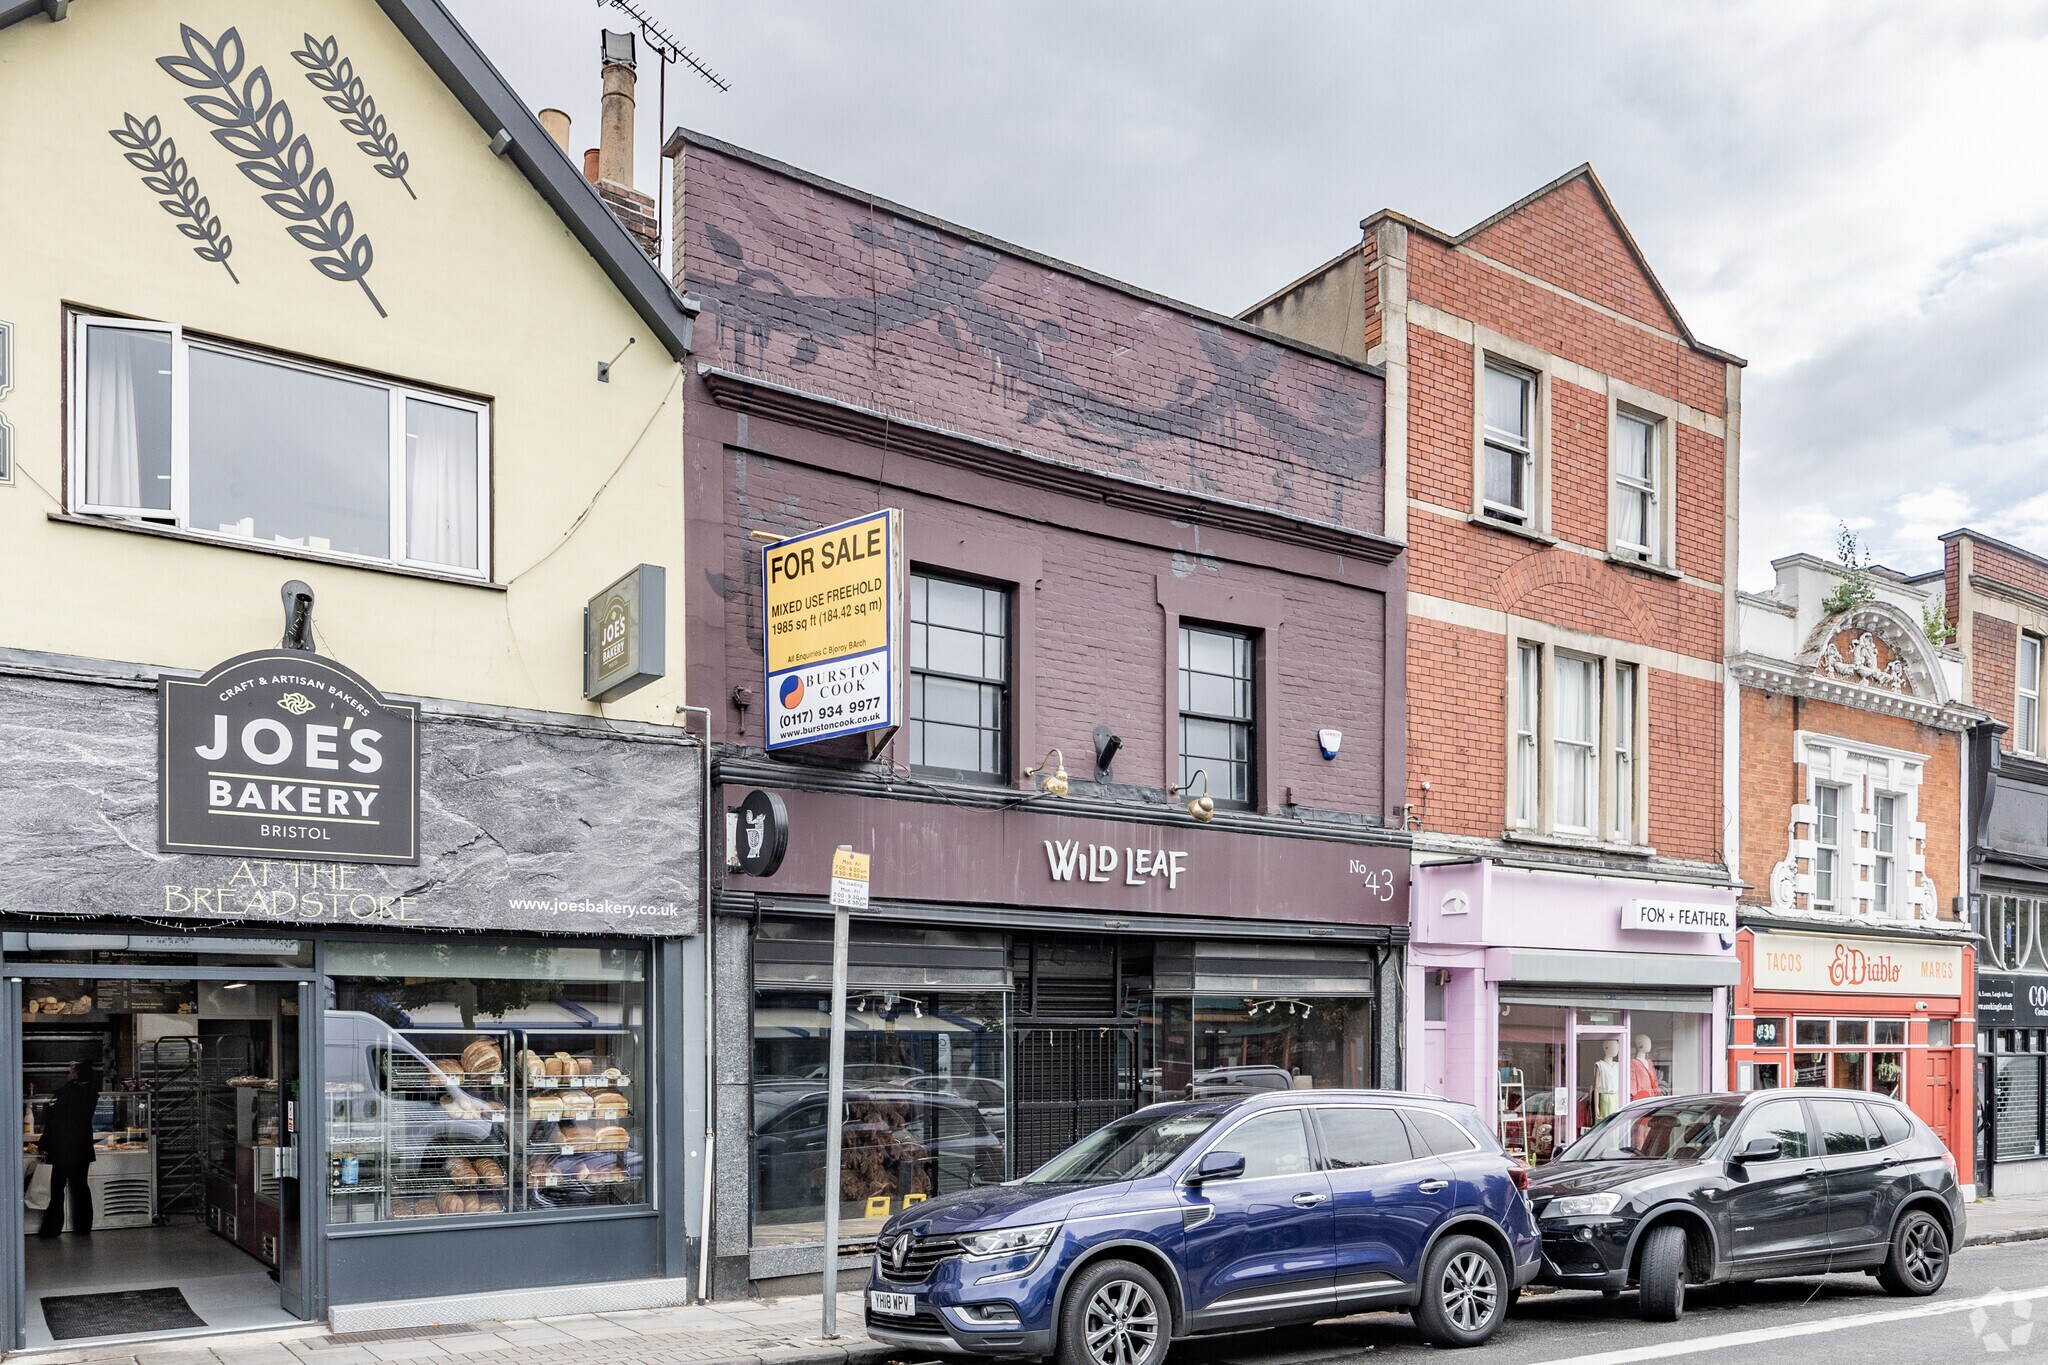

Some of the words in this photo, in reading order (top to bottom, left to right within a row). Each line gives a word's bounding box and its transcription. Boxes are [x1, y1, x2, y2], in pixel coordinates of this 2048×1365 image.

[771, 547, 815, 584] FOR
[821, 528, 881, 570] SALE
[771, 599, 802, 618] MIXED
[805, 592, 824, 610] USE
[827, 578, 882, 605] FREEHOLD
[602, 614, 625, 646] JOE'S
[772, 619, 794, 636] 1985
[796, 617, 807, 632] sq
[809, 613, 817, 627] ft
[818, 605, 852, 627] (184.42
[854, 603, 867, 619] sq
[868, 596, 883, 613] m)
[603, 641, 625, 662] BAKERY
[787, 654, 795, 664] All
[796, 648, 822, 662] Enquiries
[822, 646, 828, 655] C
[848, 639, 867, 651] BArch
[806, 660, 881, 688] BURSTON
[819, 678, 866, 699] COOK
[219, 679, 255, 702] CRAFT
[258, 676, 268, 686] &
[272, 674, 325, 691] ARTISAN
[328, 684, 370, 718] BAKERS
[779, 708, 814, 729] (0117)
[818, 703, 844, 720] 934
[849, 696, 881, 714] 9977
[779, 711, 881, 740] www.burstoncook.co.uk
[194, 714, 384, 775] JOE'S
[208, 778, 379, 817] BAKERY
[260, 824, 331, 841] BRISTOL
[228, 860, 279, 887] AT
[285, 862, 363, 892] THE
[1043, 838, 1119, 883] WILD
[1125, 846, 1189, 890] LEAF
[1349, 859, 1367, 875] No
[1364, 869, 1395, 902] 43
[163, 885, 424, 921] BREADSTORE
[508, 897, 679, 918] www.joesbakery.co.uk
[1640, 906, 1665, 923] FOX
[1668, 913, 1675, 921] +
[1678, 909, 1730, 928] FEATHER.
[1766, 951, 1802, 973] TACOS
[1828, 943, 1849, 986] El
[1847, 945, 1902, 986] Diablo
[1921, 960, 1953, 979] MARGS
[2028, 985, 2048, 1007] CO
[1763, 1023, 1776, 1041] 39
[875, 1293, 891, 1309] YH18
[893, 1295, 908, 1311] WPV
